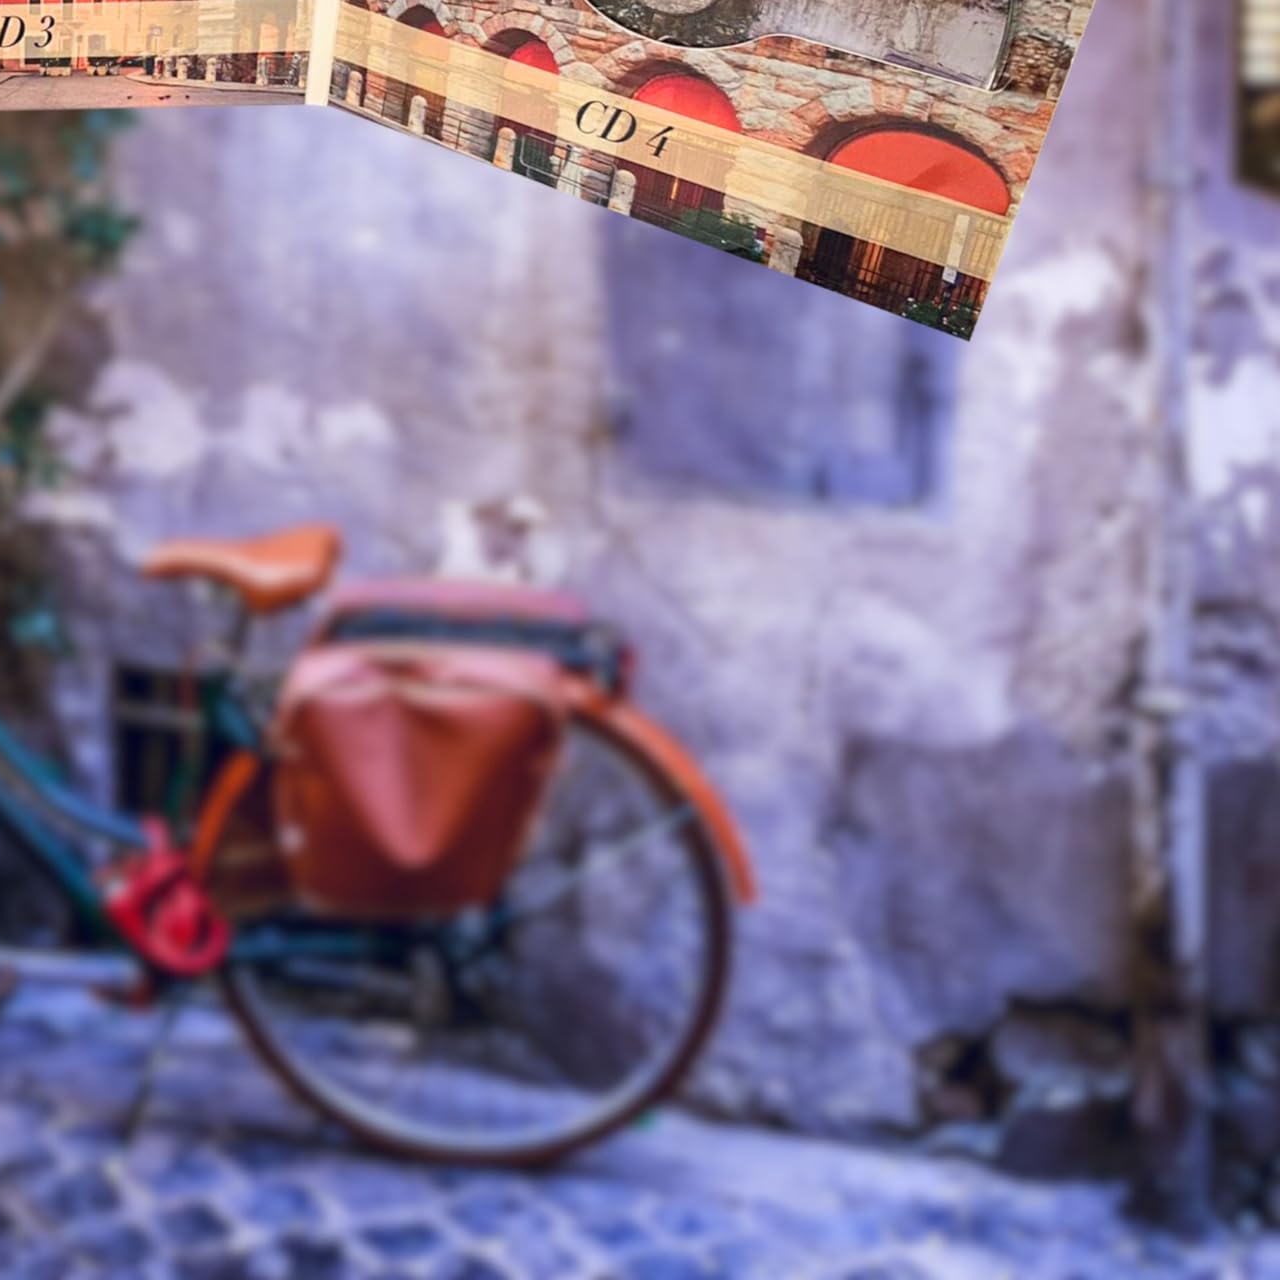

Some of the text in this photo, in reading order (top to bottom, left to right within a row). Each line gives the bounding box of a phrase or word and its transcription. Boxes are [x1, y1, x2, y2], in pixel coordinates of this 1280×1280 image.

[33, 15, 55, 48] 3
[576, 100, 674, 157] CD 4
